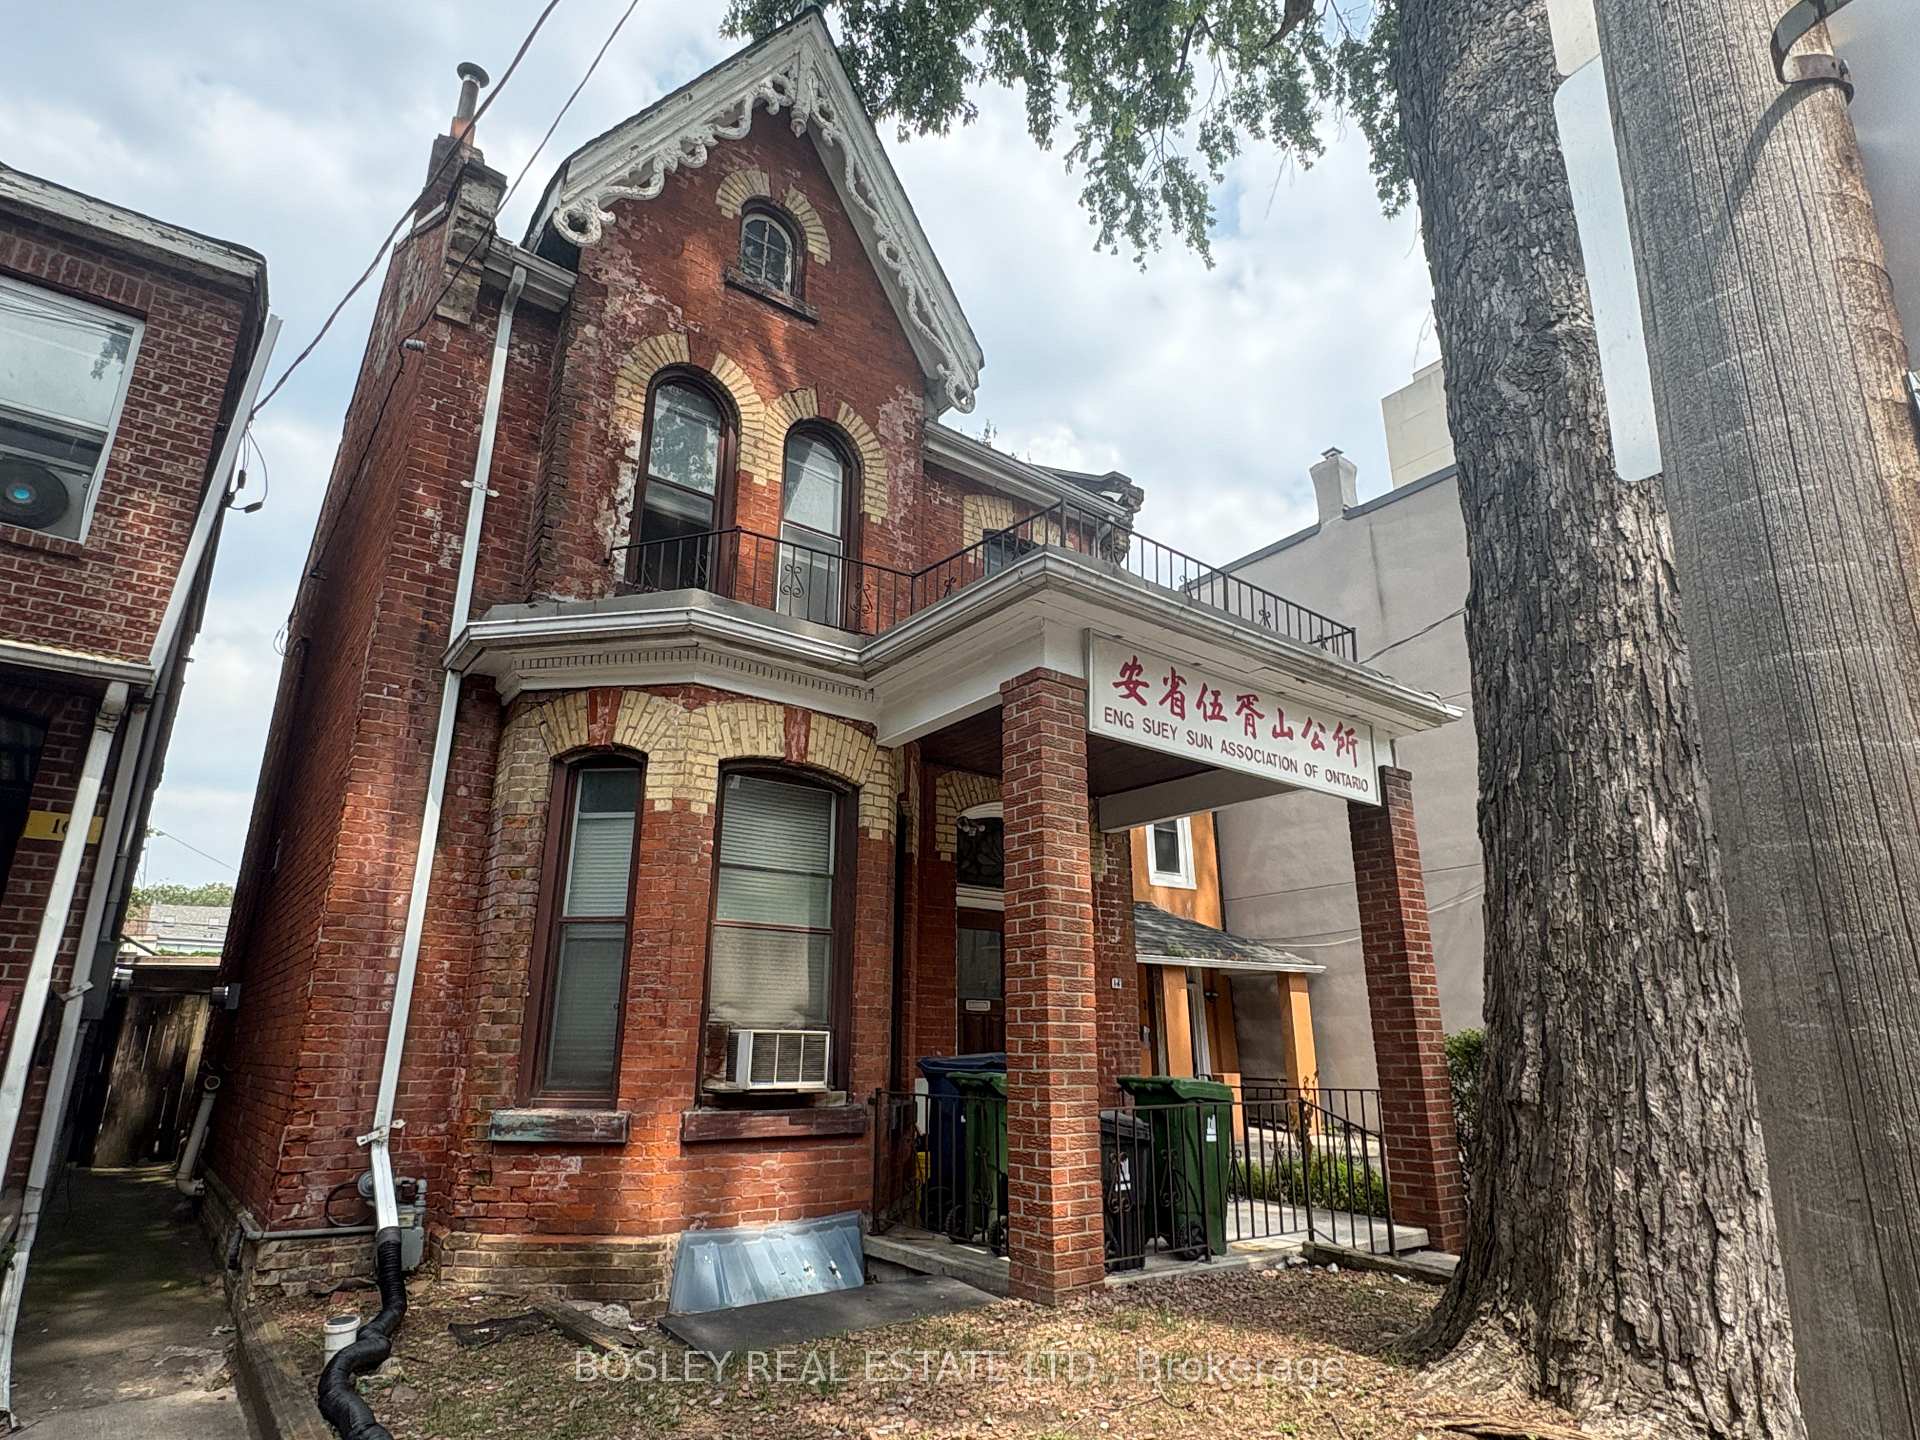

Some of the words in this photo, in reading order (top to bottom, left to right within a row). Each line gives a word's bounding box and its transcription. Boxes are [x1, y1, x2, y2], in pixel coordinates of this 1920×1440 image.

[1104, 706, 1134, 730] ENG
[1142, 717, 1178, 741] SUEY
[1186, 729, 1213, 750] SUN
[1220, 739, 1298, 774] ASSOCIATION
[1304, 763, 1319, 778] OF
[1325, 769, 1369, 793] ONTARIO
[1112, 655, 1358, 768] 安省伍胥山公所
